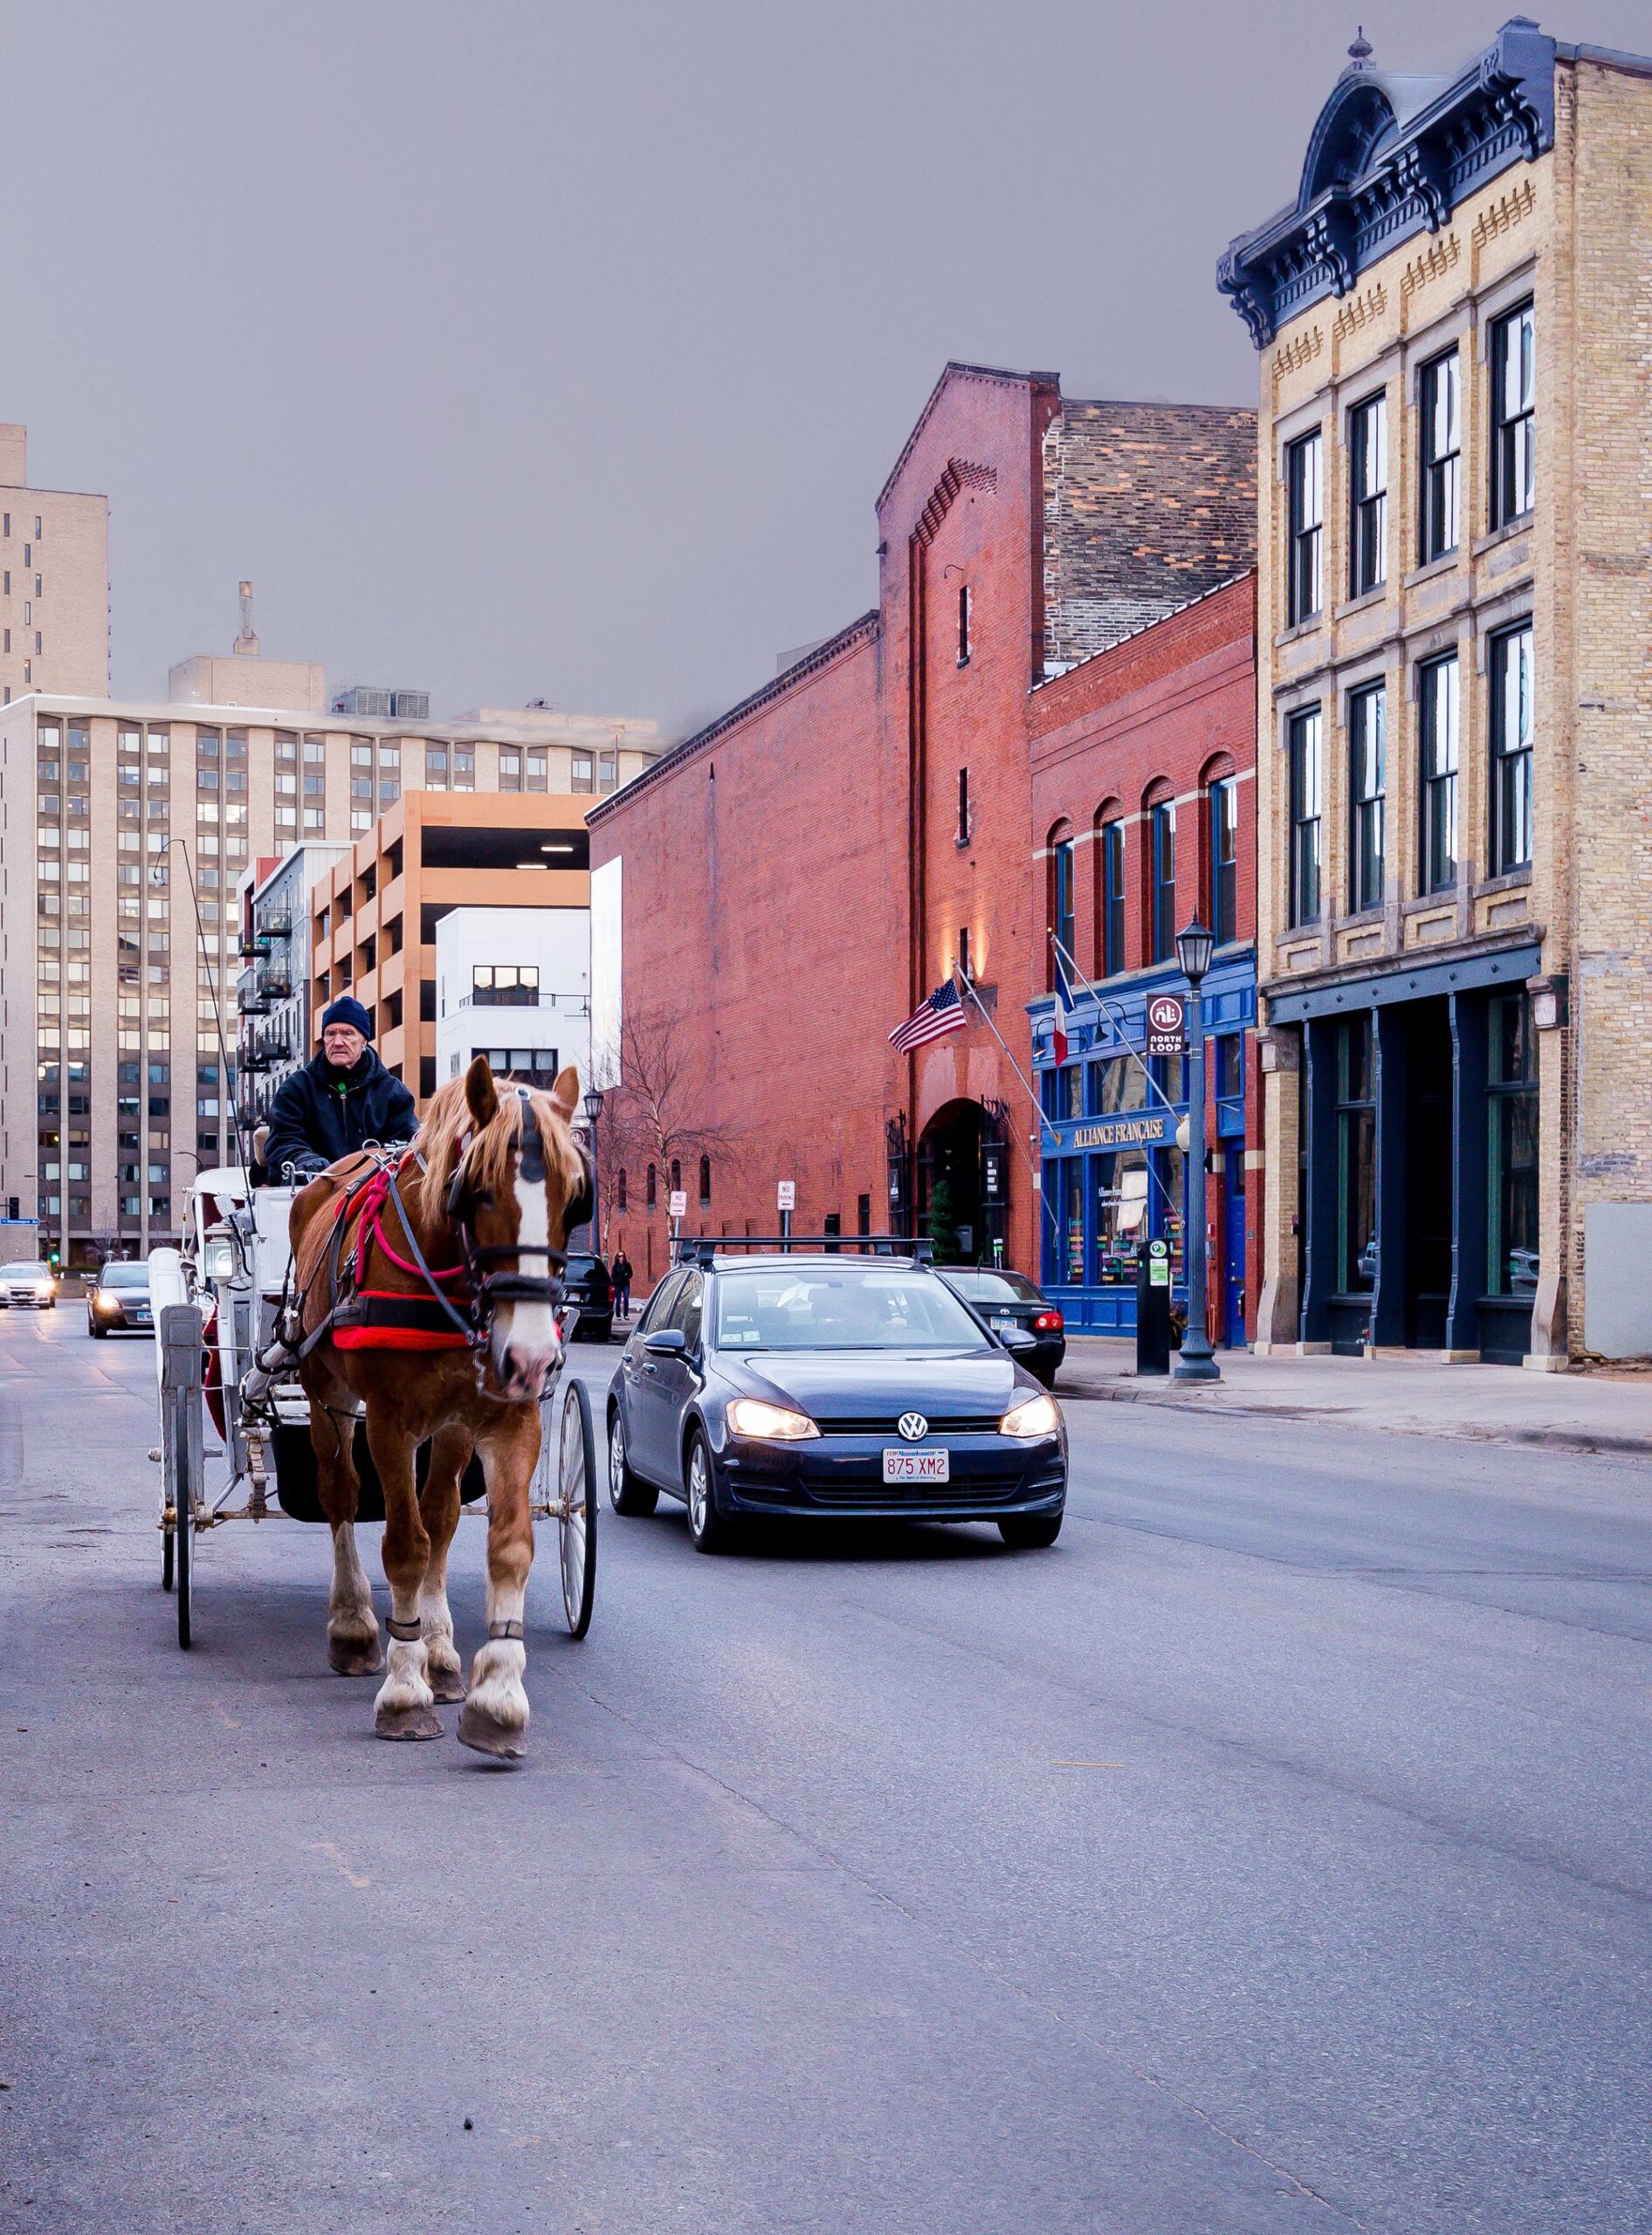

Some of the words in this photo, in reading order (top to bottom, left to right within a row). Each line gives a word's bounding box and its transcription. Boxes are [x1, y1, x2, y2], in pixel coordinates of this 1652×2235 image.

[1150, 1043, 1181, 1052] LOOP
[1074, 1125, 1114, 1148] ALLIANCE
[1115, 1119, 1164, 1145] FRANÇAISE
[887, 1458, 914, 1475] 875
[919, 1458, 945, 1475] XM2
